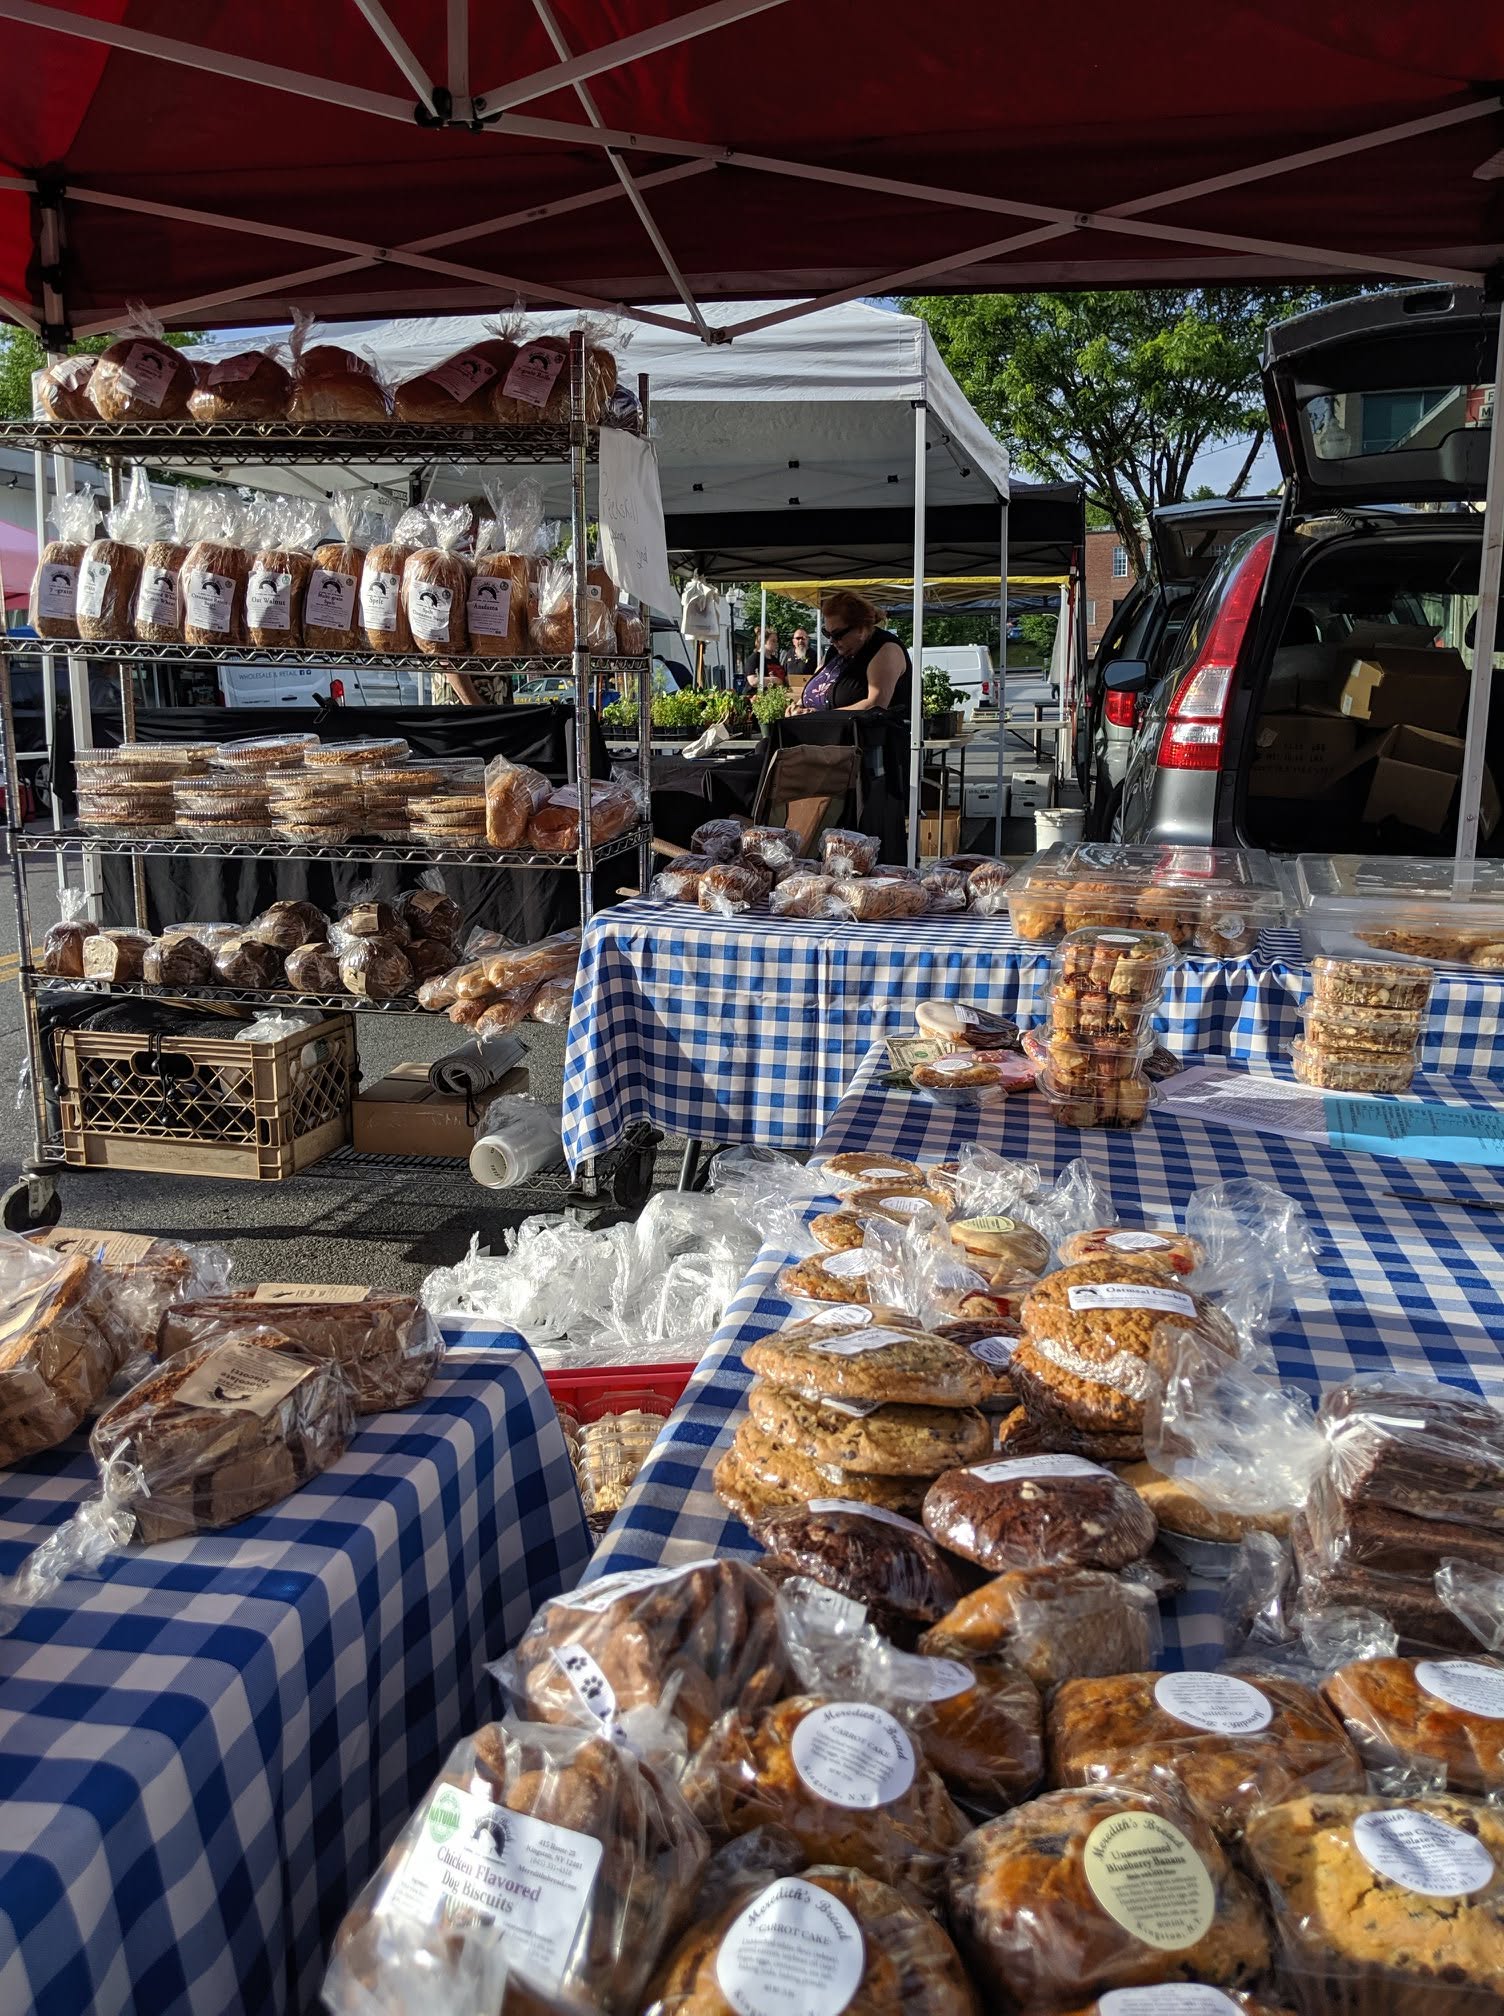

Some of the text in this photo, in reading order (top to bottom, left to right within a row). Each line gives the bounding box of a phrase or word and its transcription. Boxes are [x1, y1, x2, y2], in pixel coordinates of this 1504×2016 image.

[239, 671, 272, 680] WHOLESALE
[279, 670, 298, 678] RETAIL
[1106, 1285, 1150, 1295] Oatmeal
[1092, 1817, 1138, 1861] Meredith's
[437, 1846, 543, 1902] Chicken Flavored
[1105, 1856, 1187, 1874] Blueberry Banana
[441, 1870, 513, 1914] Dog Biscuits
[747, 1886, 852, 1942] Meredith's Bread
